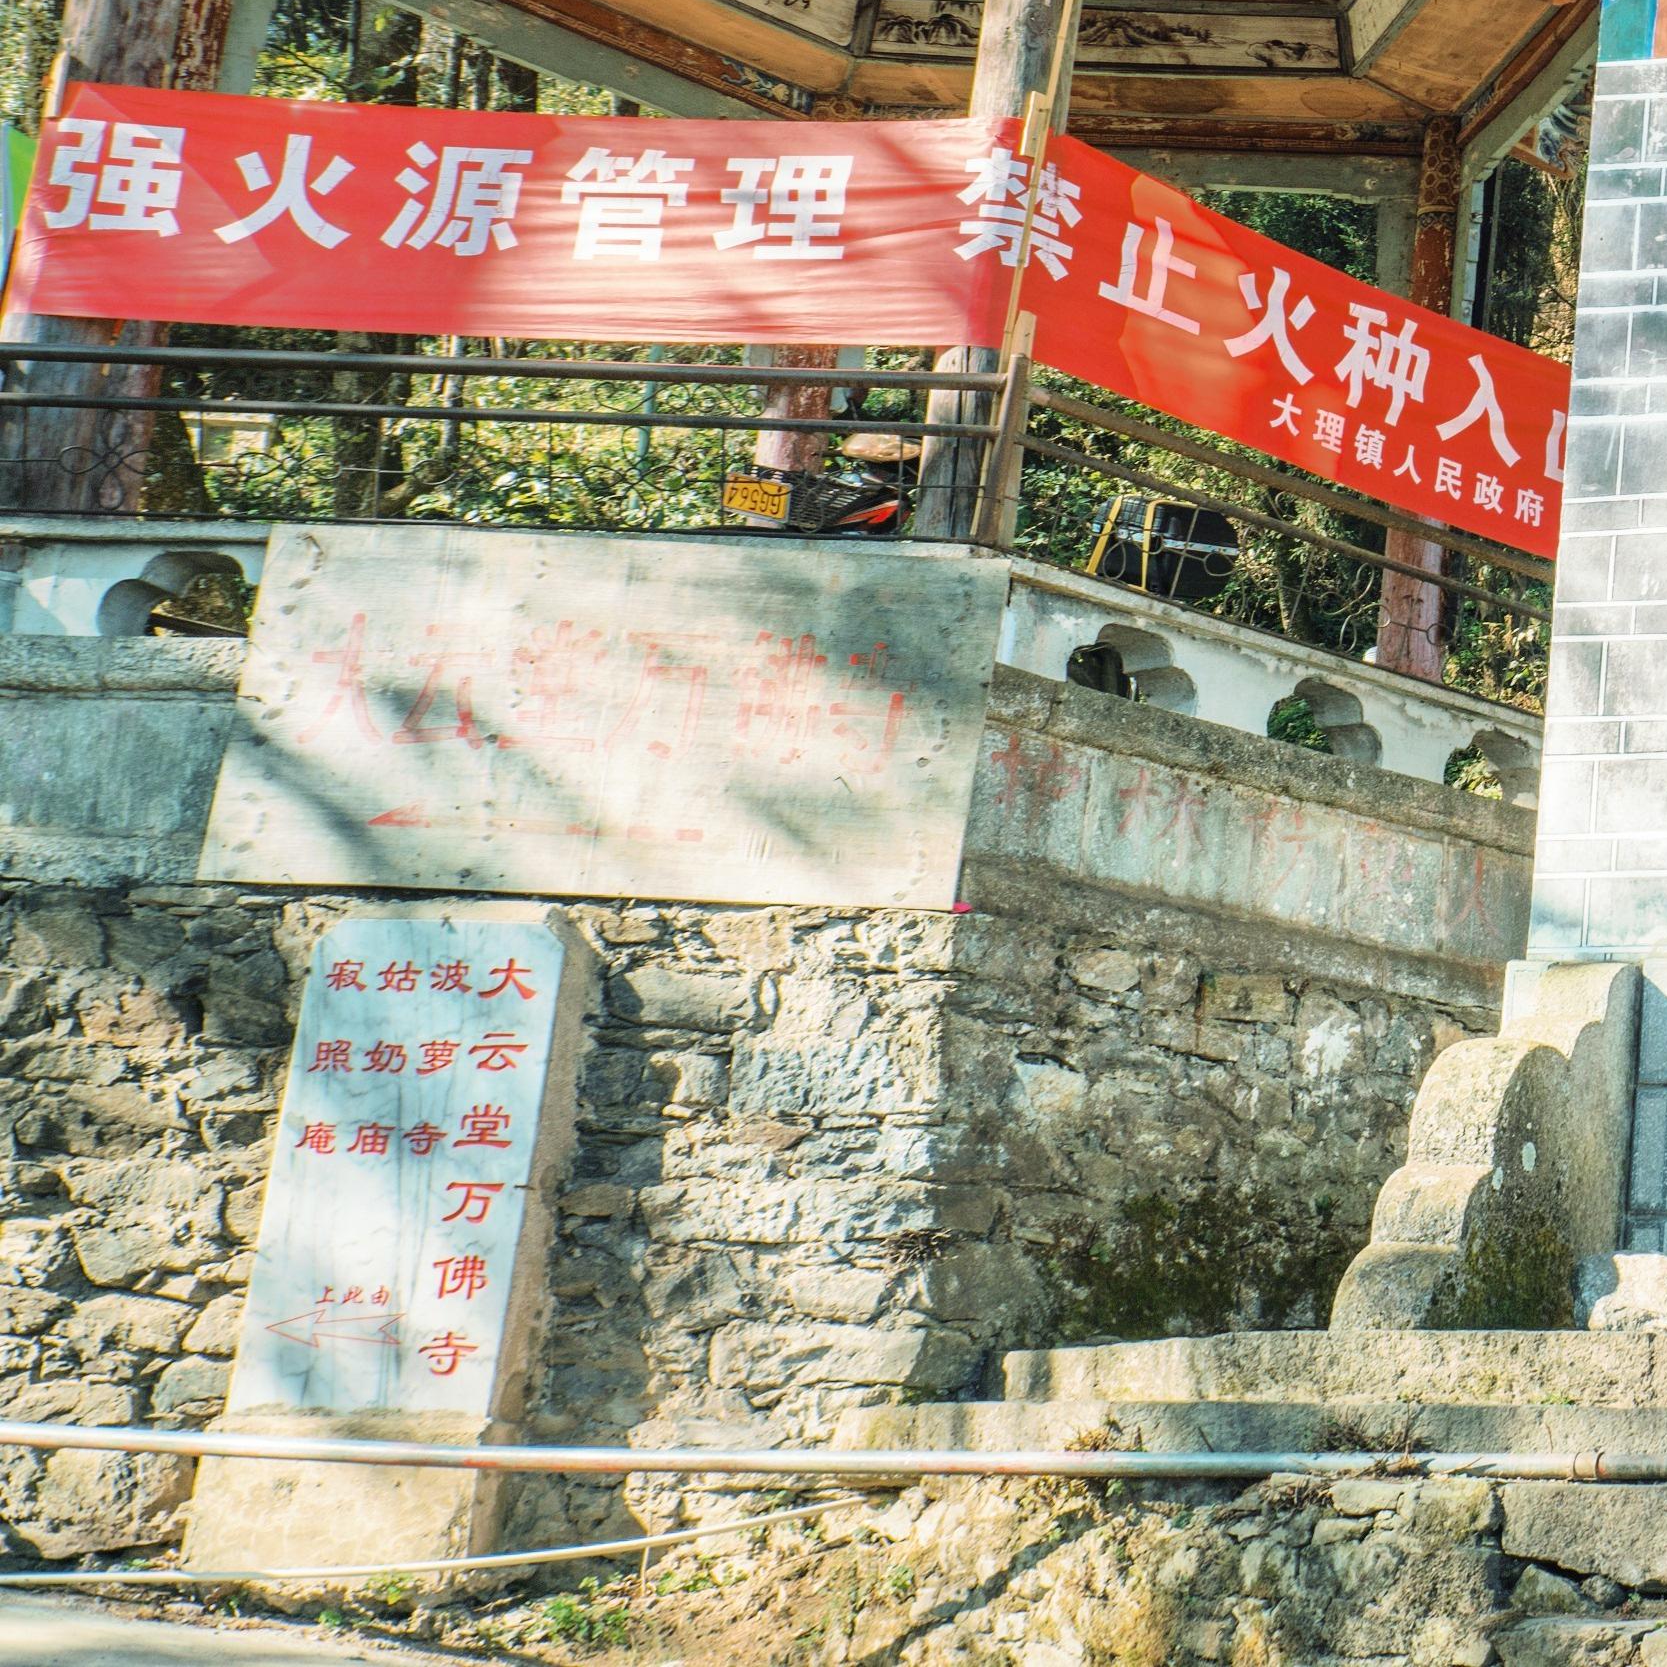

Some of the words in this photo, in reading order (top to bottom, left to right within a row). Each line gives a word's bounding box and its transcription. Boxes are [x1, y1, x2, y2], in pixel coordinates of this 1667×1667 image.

[43, 117, 856, 261] 强火源管理
[1269, 392, 1545, 529] 大理镇人民政府
[296, 612, 917, 775] 大云堂万佛寺
[294, 958, 369, 1156] 寂照庵
[347, 959, 422, 1156] 姑奶庙
[402, 961, 474, 1157] 波萝寺
[418, 957, 538, 1376] 大云堂万佛寺
